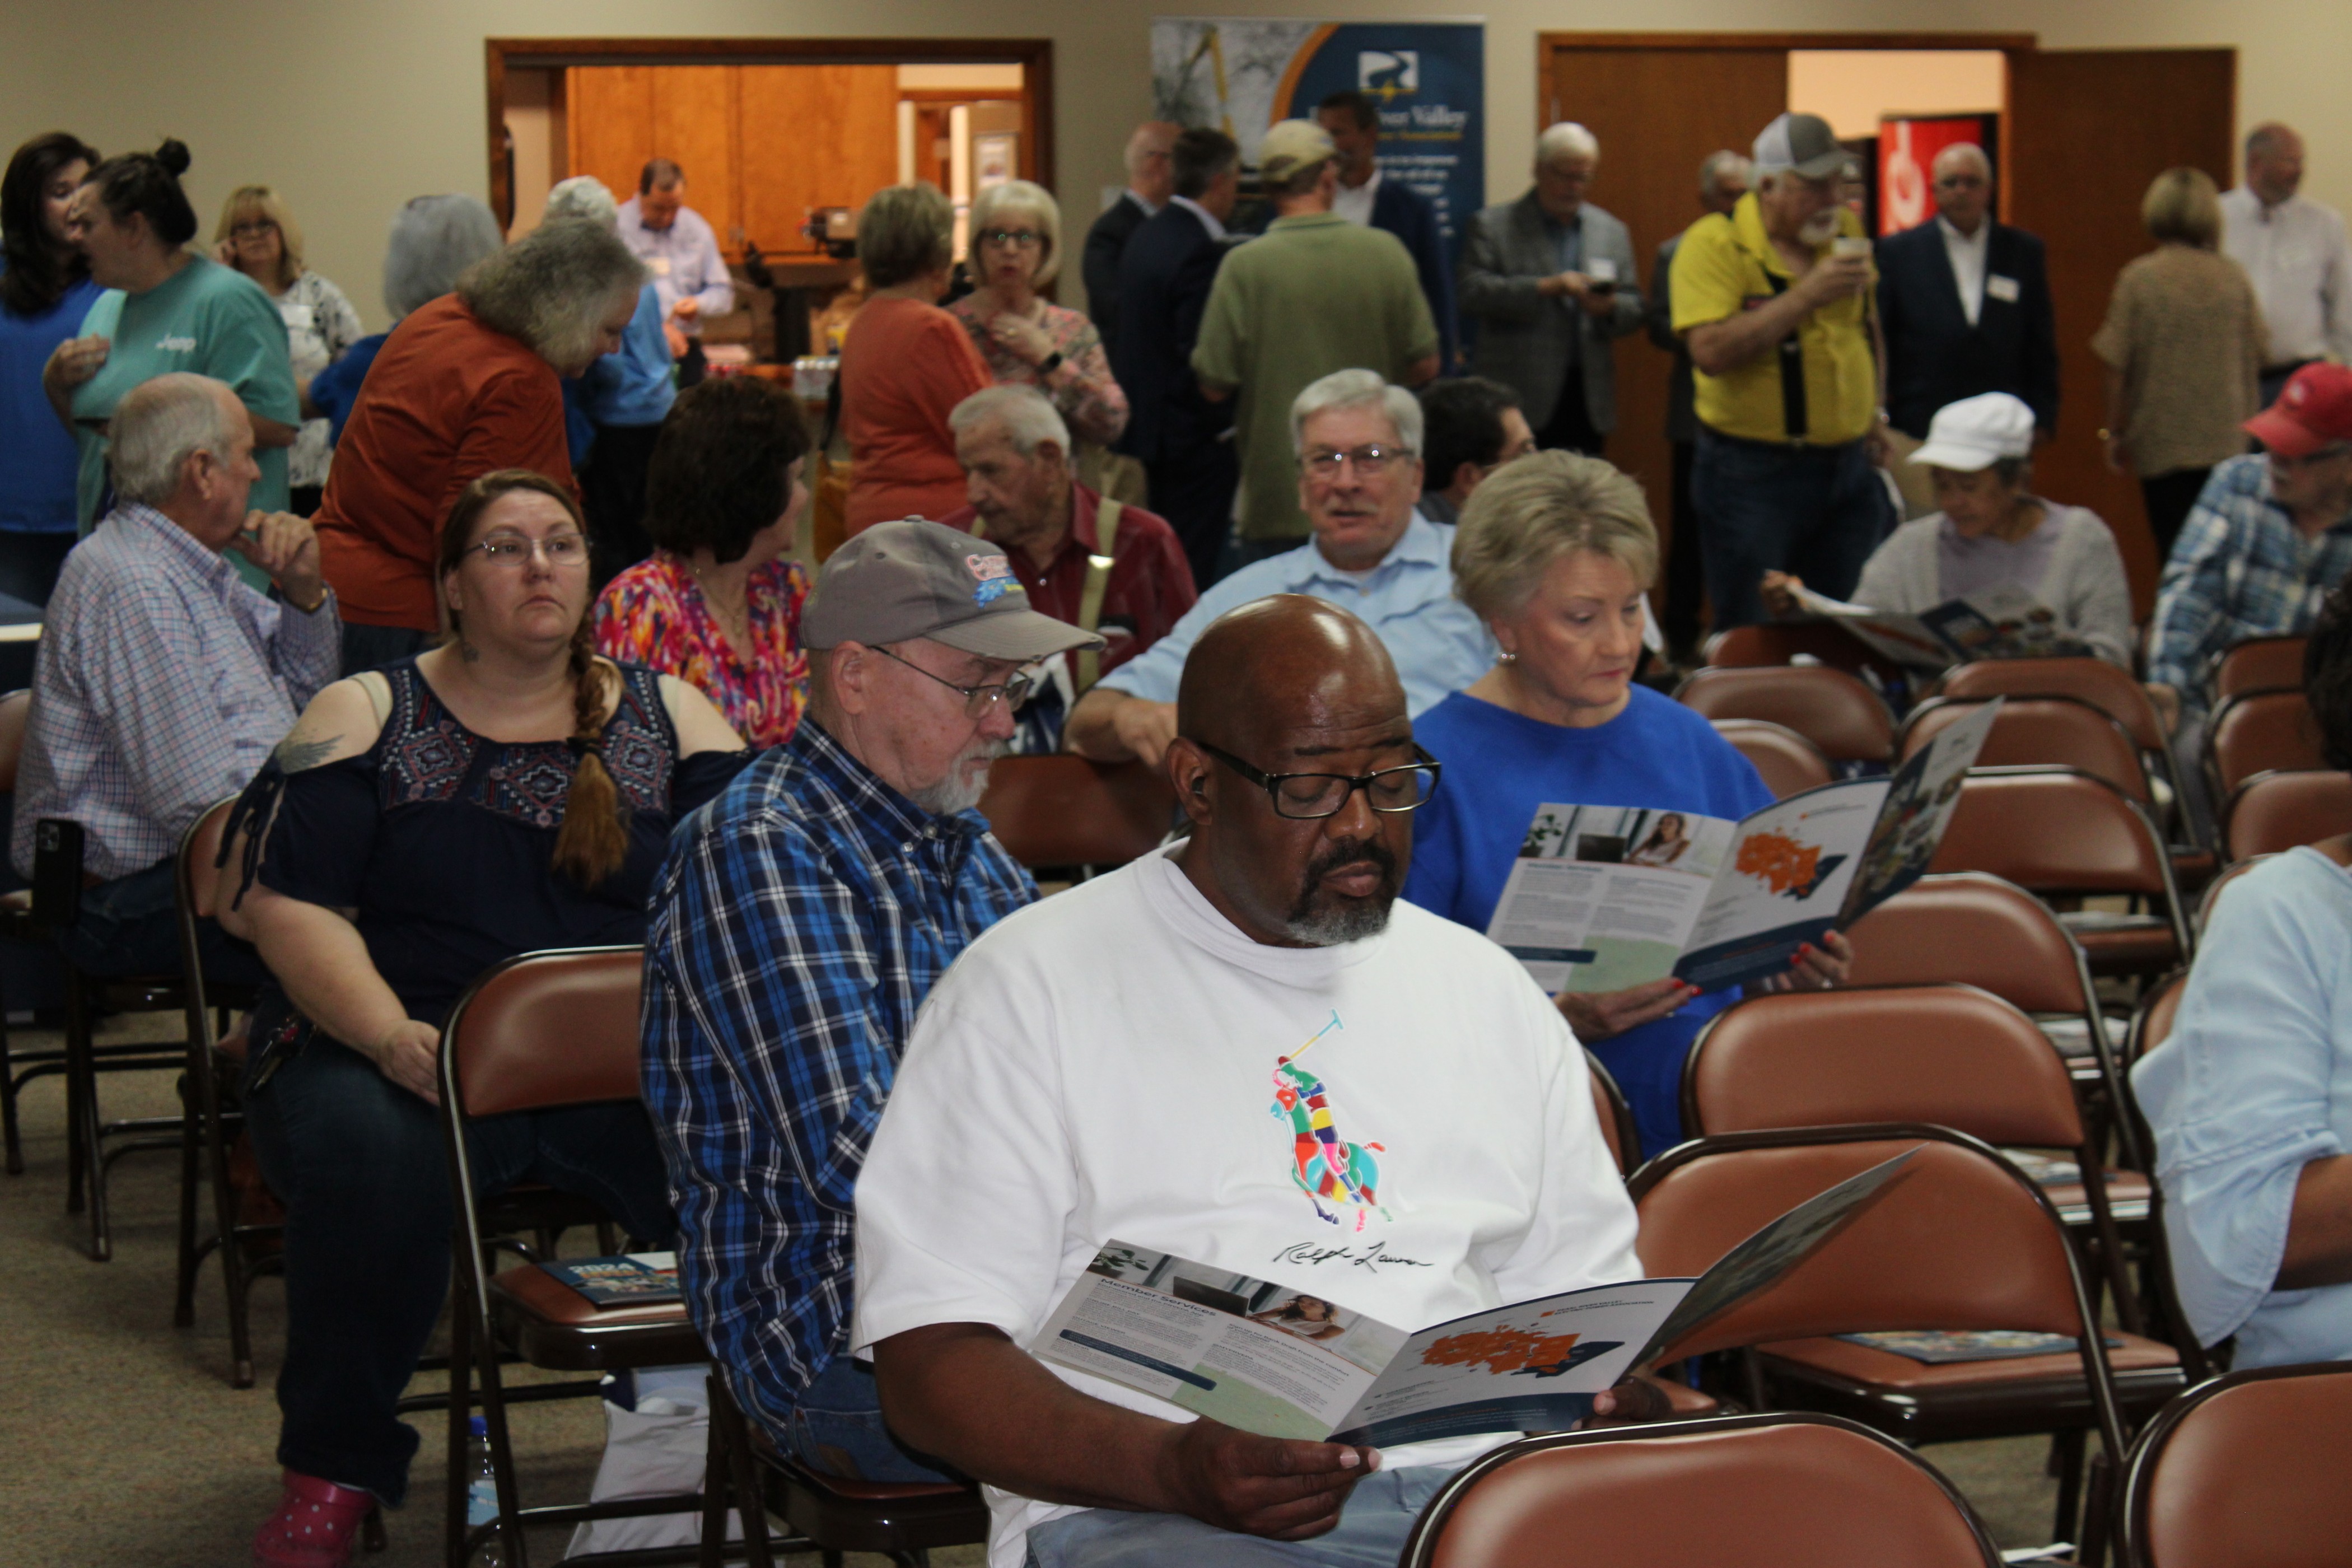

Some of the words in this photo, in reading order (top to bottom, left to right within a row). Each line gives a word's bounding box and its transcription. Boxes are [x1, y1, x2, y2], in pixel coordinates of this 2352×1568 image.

[1411, 105, 1469, 130] Valley
[156, 333, 197, 353] Jeep
[1100, 1278, 1158, 1298] Member
[1160, 1295, 1217, 1317] Services
